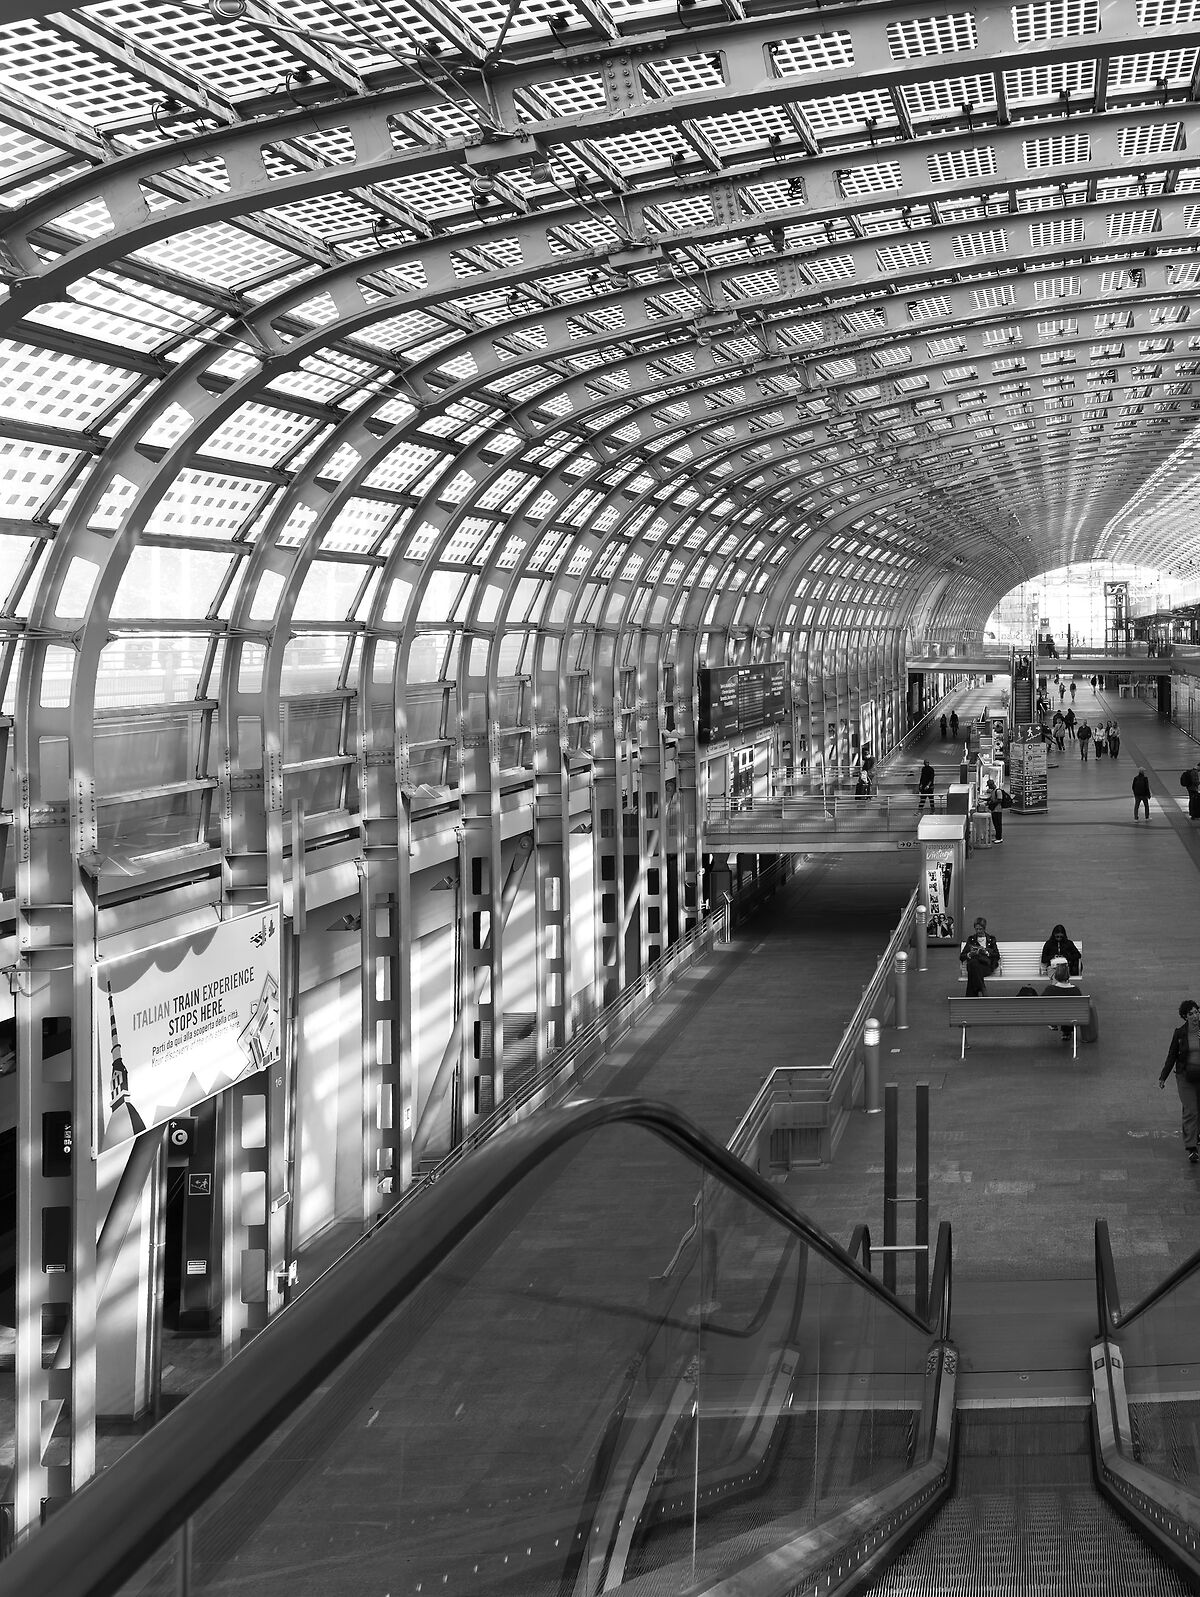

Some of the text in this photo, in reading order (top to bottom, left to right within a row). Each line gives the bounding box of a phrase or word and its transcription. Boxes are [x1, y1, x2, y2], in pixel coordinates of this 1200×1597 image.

[133, 966, 255, 1031] ITALIAN TRAIN EXPERIENCE
[168, 998, 226, 1036] STOPS HERE.
[152, 1042, 166, 1056] Parti
[166, 1038, 174, 1050] da
[174, 1036, 183, 1048] qui
[183, 1031, 193, 1042] alla
[193, 1021, 215, 1038] scoperta
[215, 1015, 227, 1027] della
